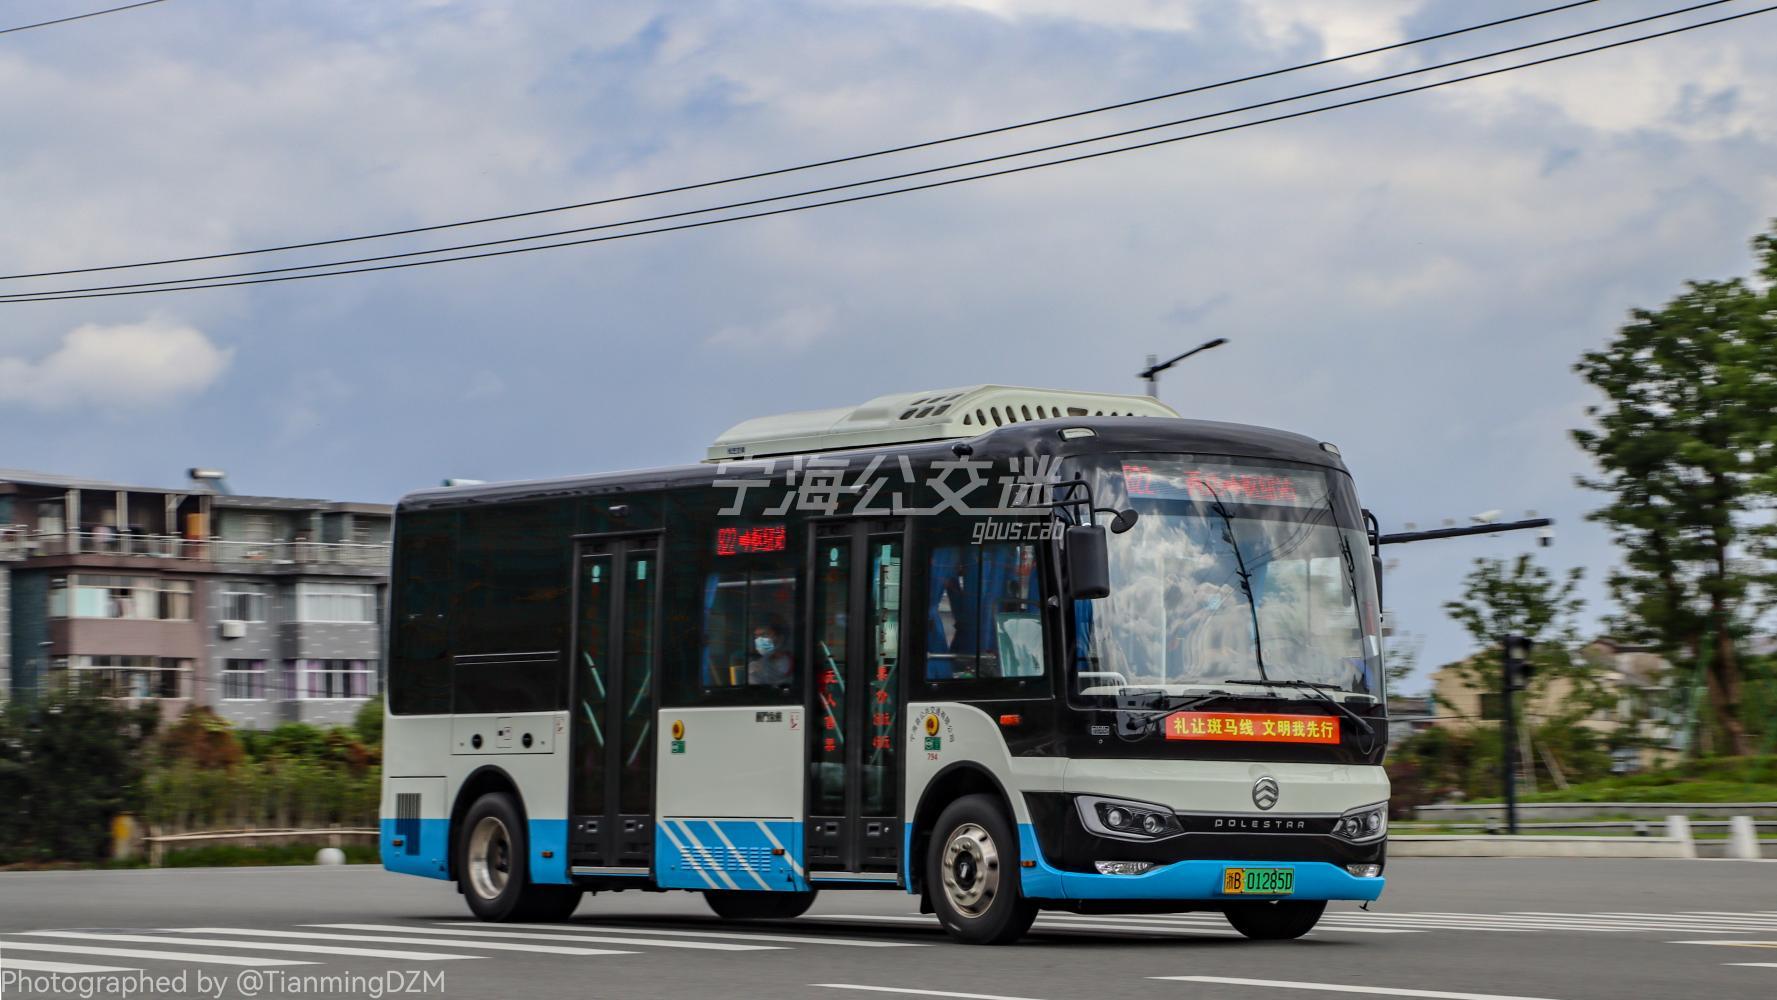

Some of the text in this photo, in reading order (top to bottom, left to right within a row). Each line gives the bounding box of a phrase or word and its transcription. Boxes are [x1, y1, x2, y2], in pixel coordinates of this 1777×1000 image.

[1173, 717, 1334, 739] 礼让斑马线 文明我先行
[1214, 818, 1305, 829] POLESTAR
[1247, 871, 1293, 890] 01285D
